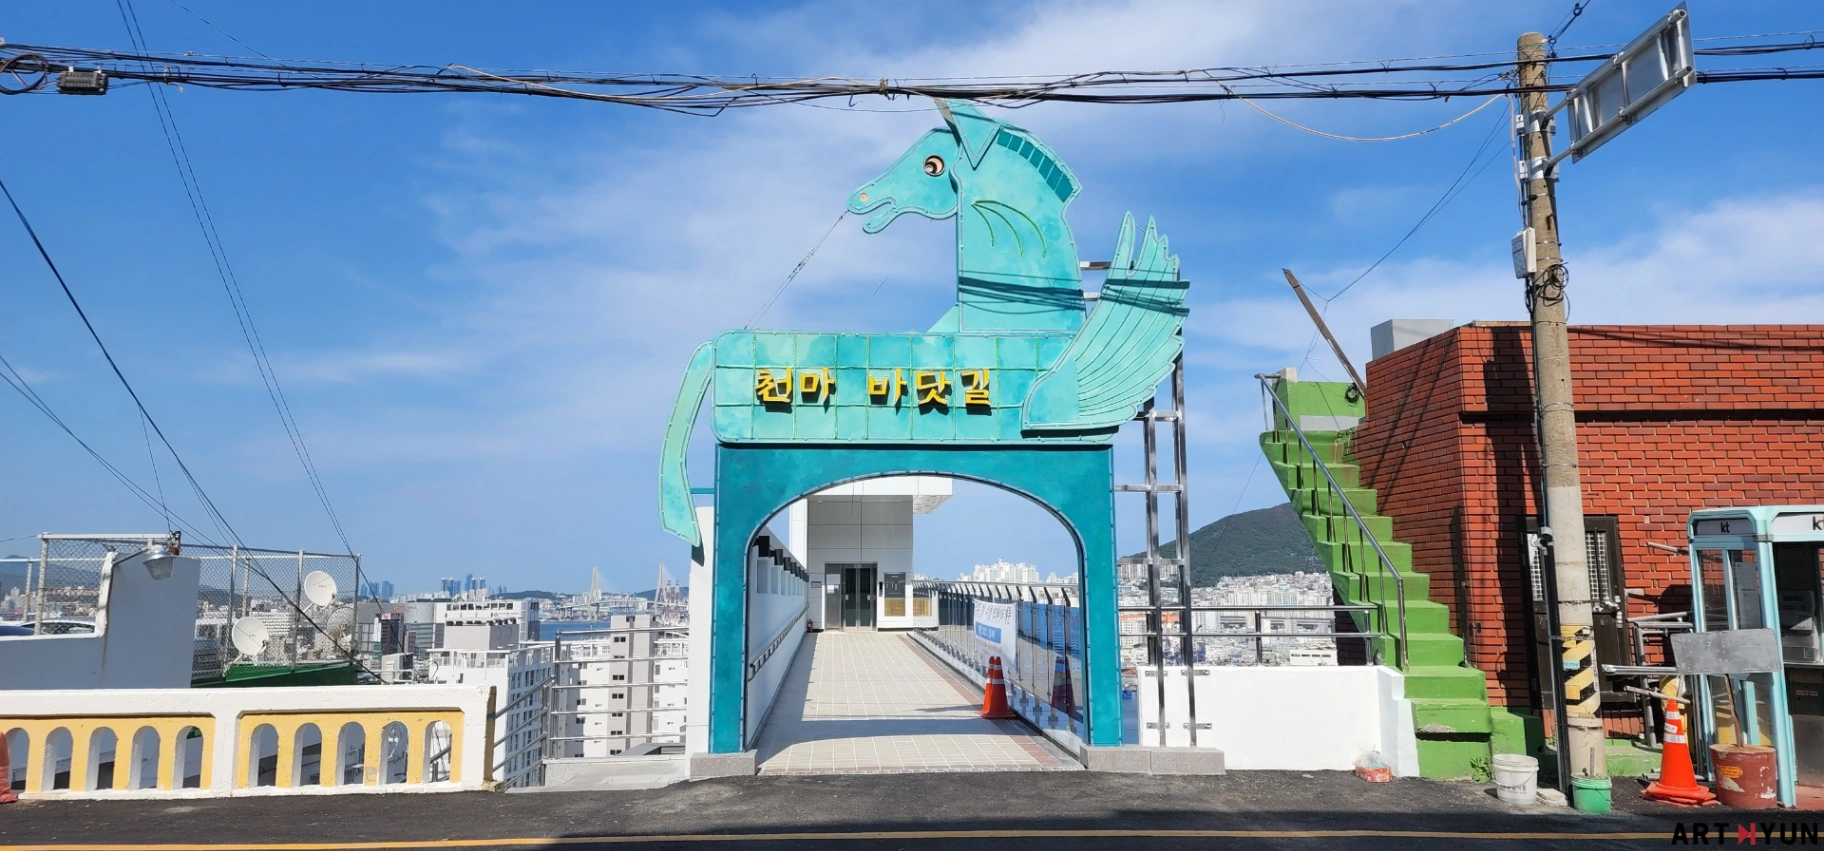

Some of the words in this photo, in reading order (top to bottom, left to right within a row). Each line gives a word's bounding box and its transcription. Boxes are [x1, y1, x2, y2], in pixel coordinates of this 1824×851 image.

[755, 367, 835, 403] 천마
[868, 367, 992, 405] 바닷길
[1720, 521, 1731, 533] kt
[1812, 516, 1824, 531] k
